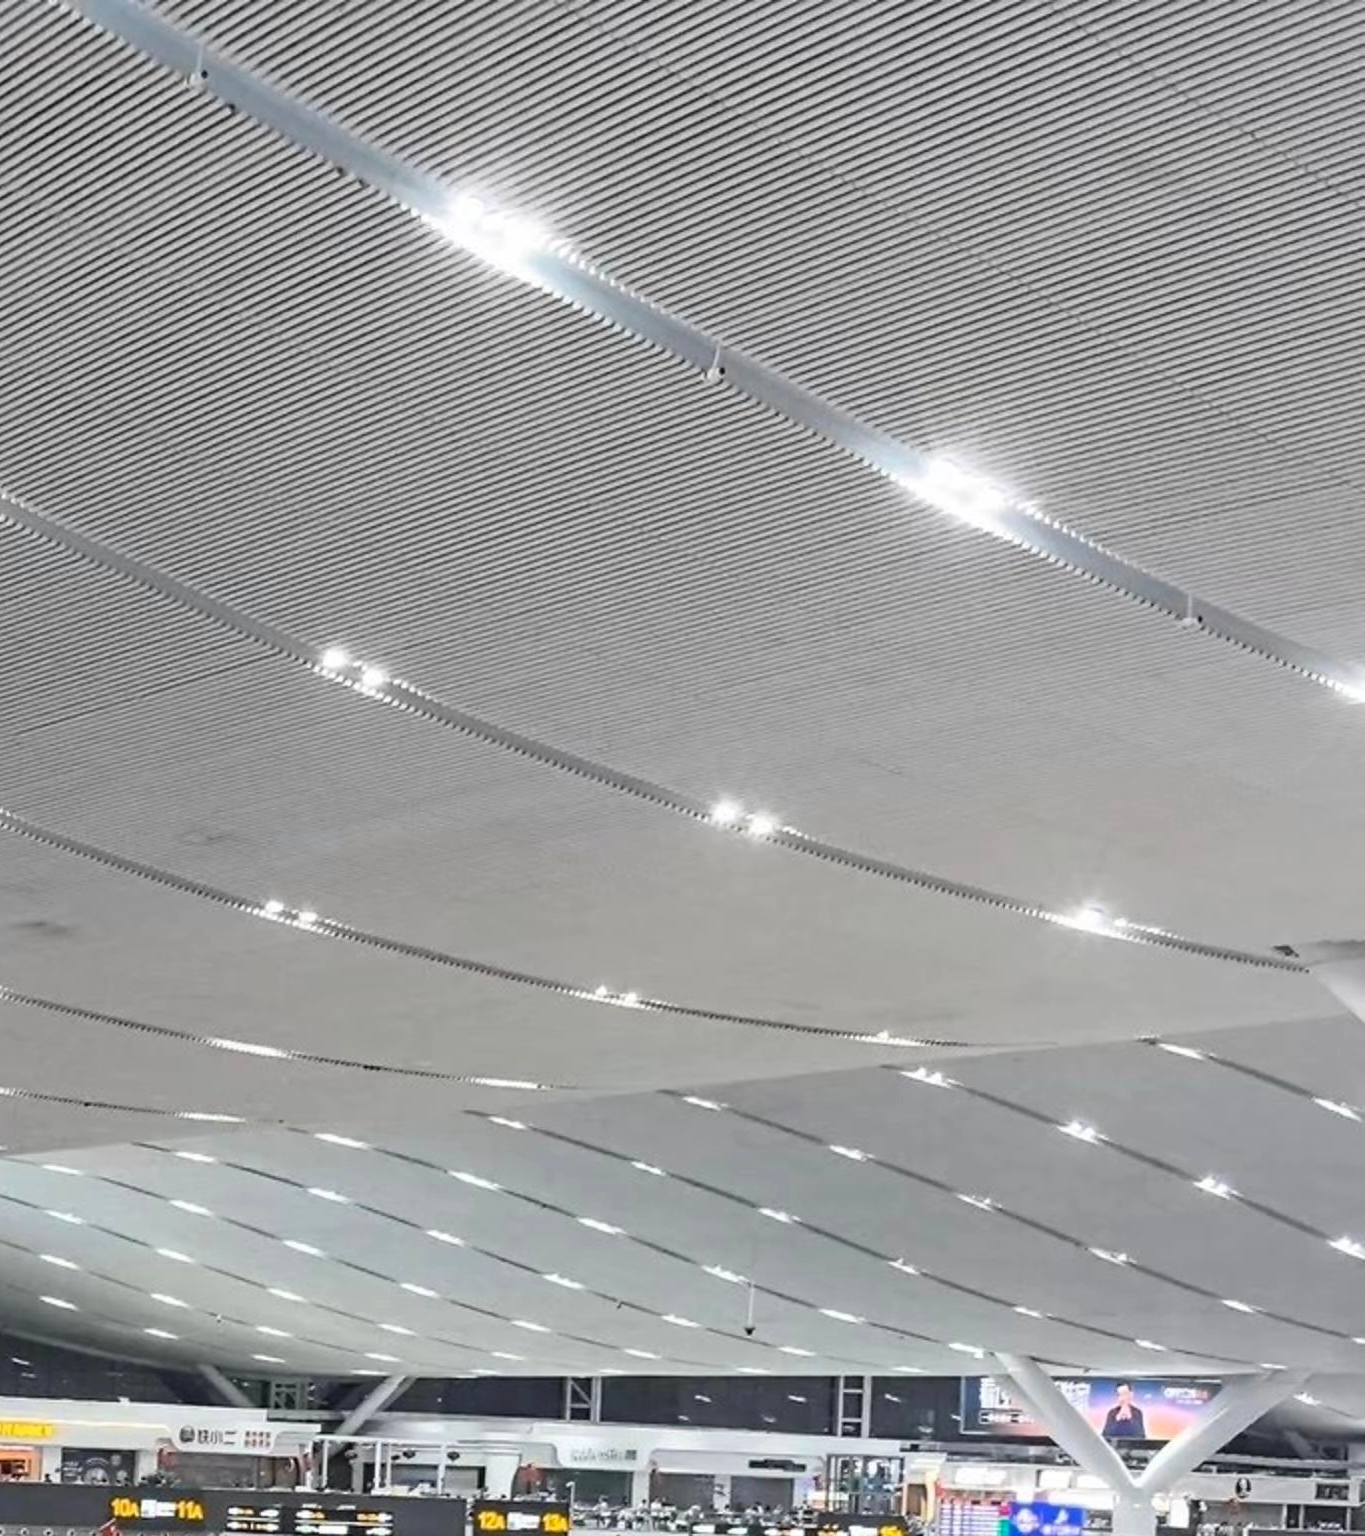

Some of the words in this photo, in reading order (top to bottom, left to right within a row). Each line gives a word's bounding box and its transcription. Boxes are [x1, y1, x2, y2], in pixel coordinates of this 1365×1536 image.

[111, 1498, 140, 1518] 10A
[177, 1499, 204, 1520] 11A
[478, 1511, 506, 1530] 12A
[543, 1513, 568, 1532] 13A
